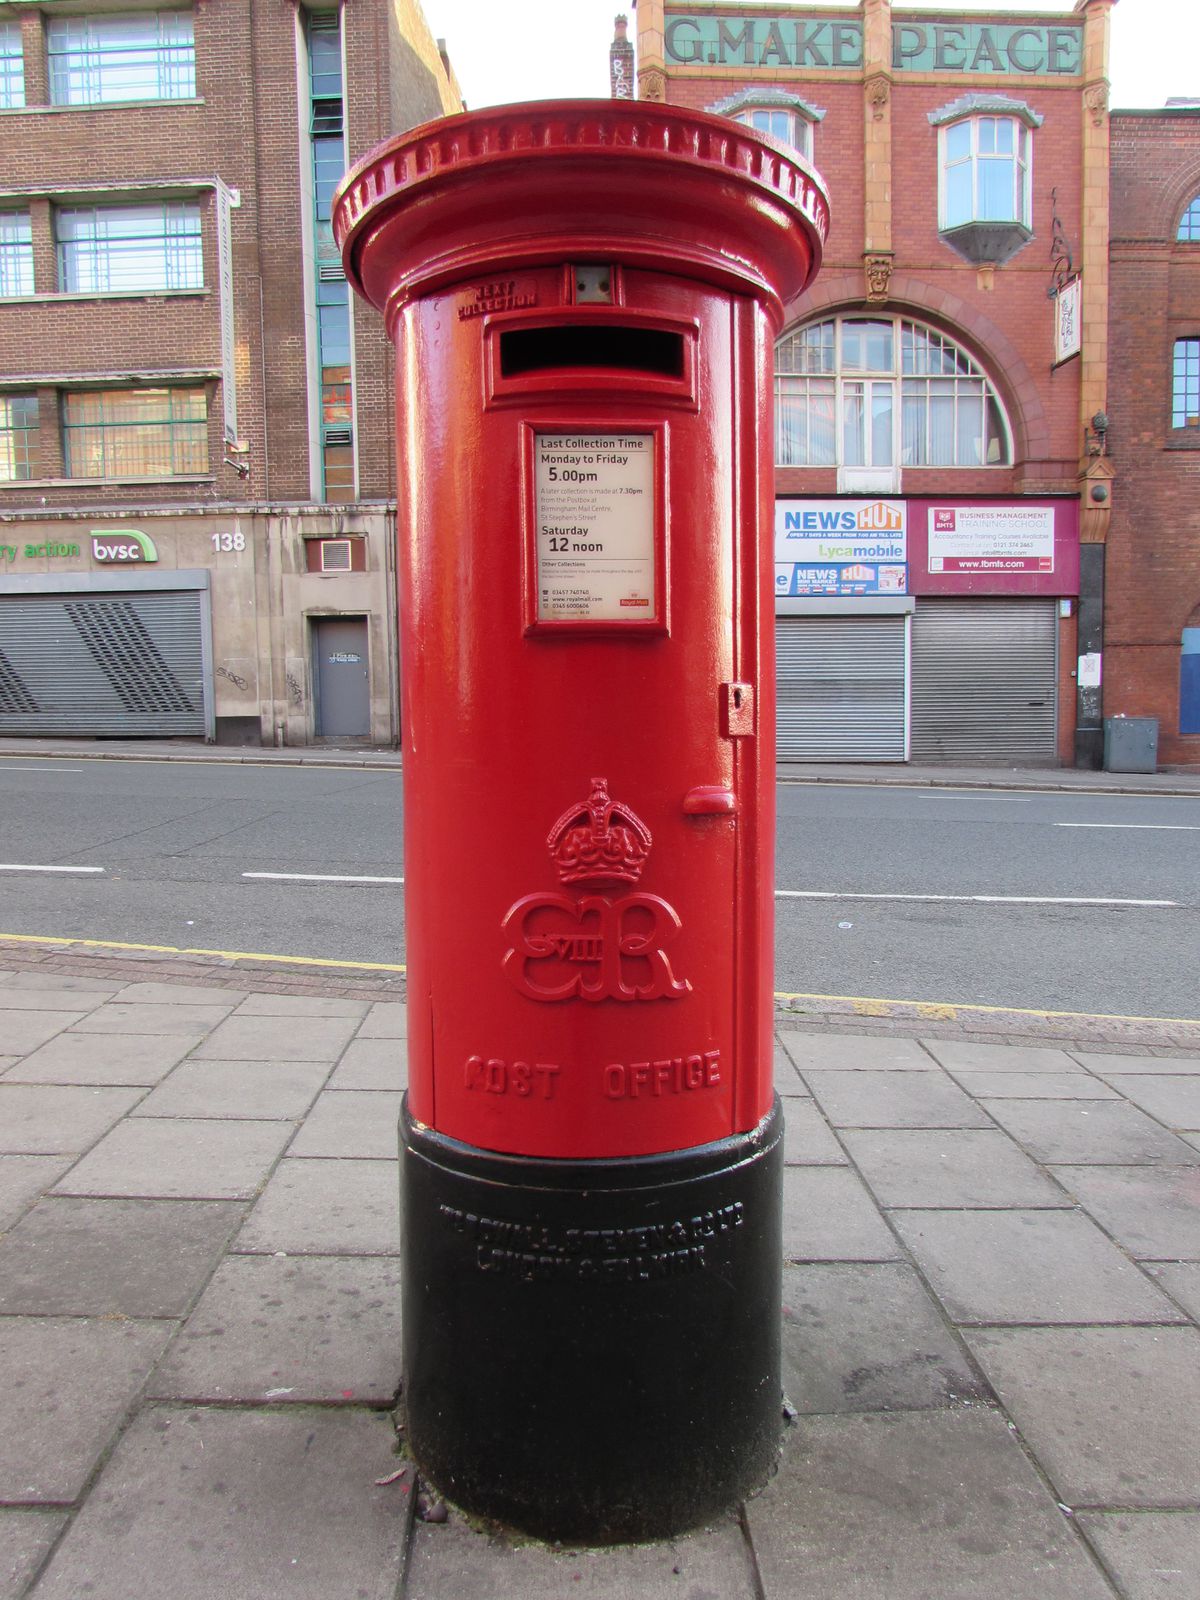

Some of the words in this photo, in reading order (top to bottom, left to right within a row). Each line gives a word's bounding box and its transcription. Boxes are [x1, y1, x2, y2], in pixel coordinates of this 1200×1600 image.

[891, 25, 1080, 72] PEACE
[473, 280, 515, 301] NEXT
[457, 292, 537, 321] COLLECTION
[541, 438, 563, 448] Last
[565, 438, 615, 448] Collection
[618, 438, 644, 448] Time
[541, 454, 581, 465] Monday
[583, 455, 594, 463] to
[596, 454, 629, 465] Friday
[548, 466, 598, 483] 5.00pm
[619, 488, 643, 496] 7.30pm
[785, 512, 856, 529] NEWS
[858, 502, 902, 529] HUT
[542, 526, 589, 537] Saturday
[960, 520, 1007, 528] TRAINING
[1009, 520, 1048, 528] SCHOOL
[24, 542, 80, 558] action
[93, 539, 139, 560] bvsc
[211, 533, 246, 552] 138
[549, 538, 569, 552] 12
[572, 542, 603, 552] noon
[819, 544, 903, 559] Lycamobile
[797, 569, 837, 580] NEWS
[841, 565, 875, 581] HUT
[464, 1055, 560, 1100] POST
[603, 1049, 722, 1099] OFFICE
